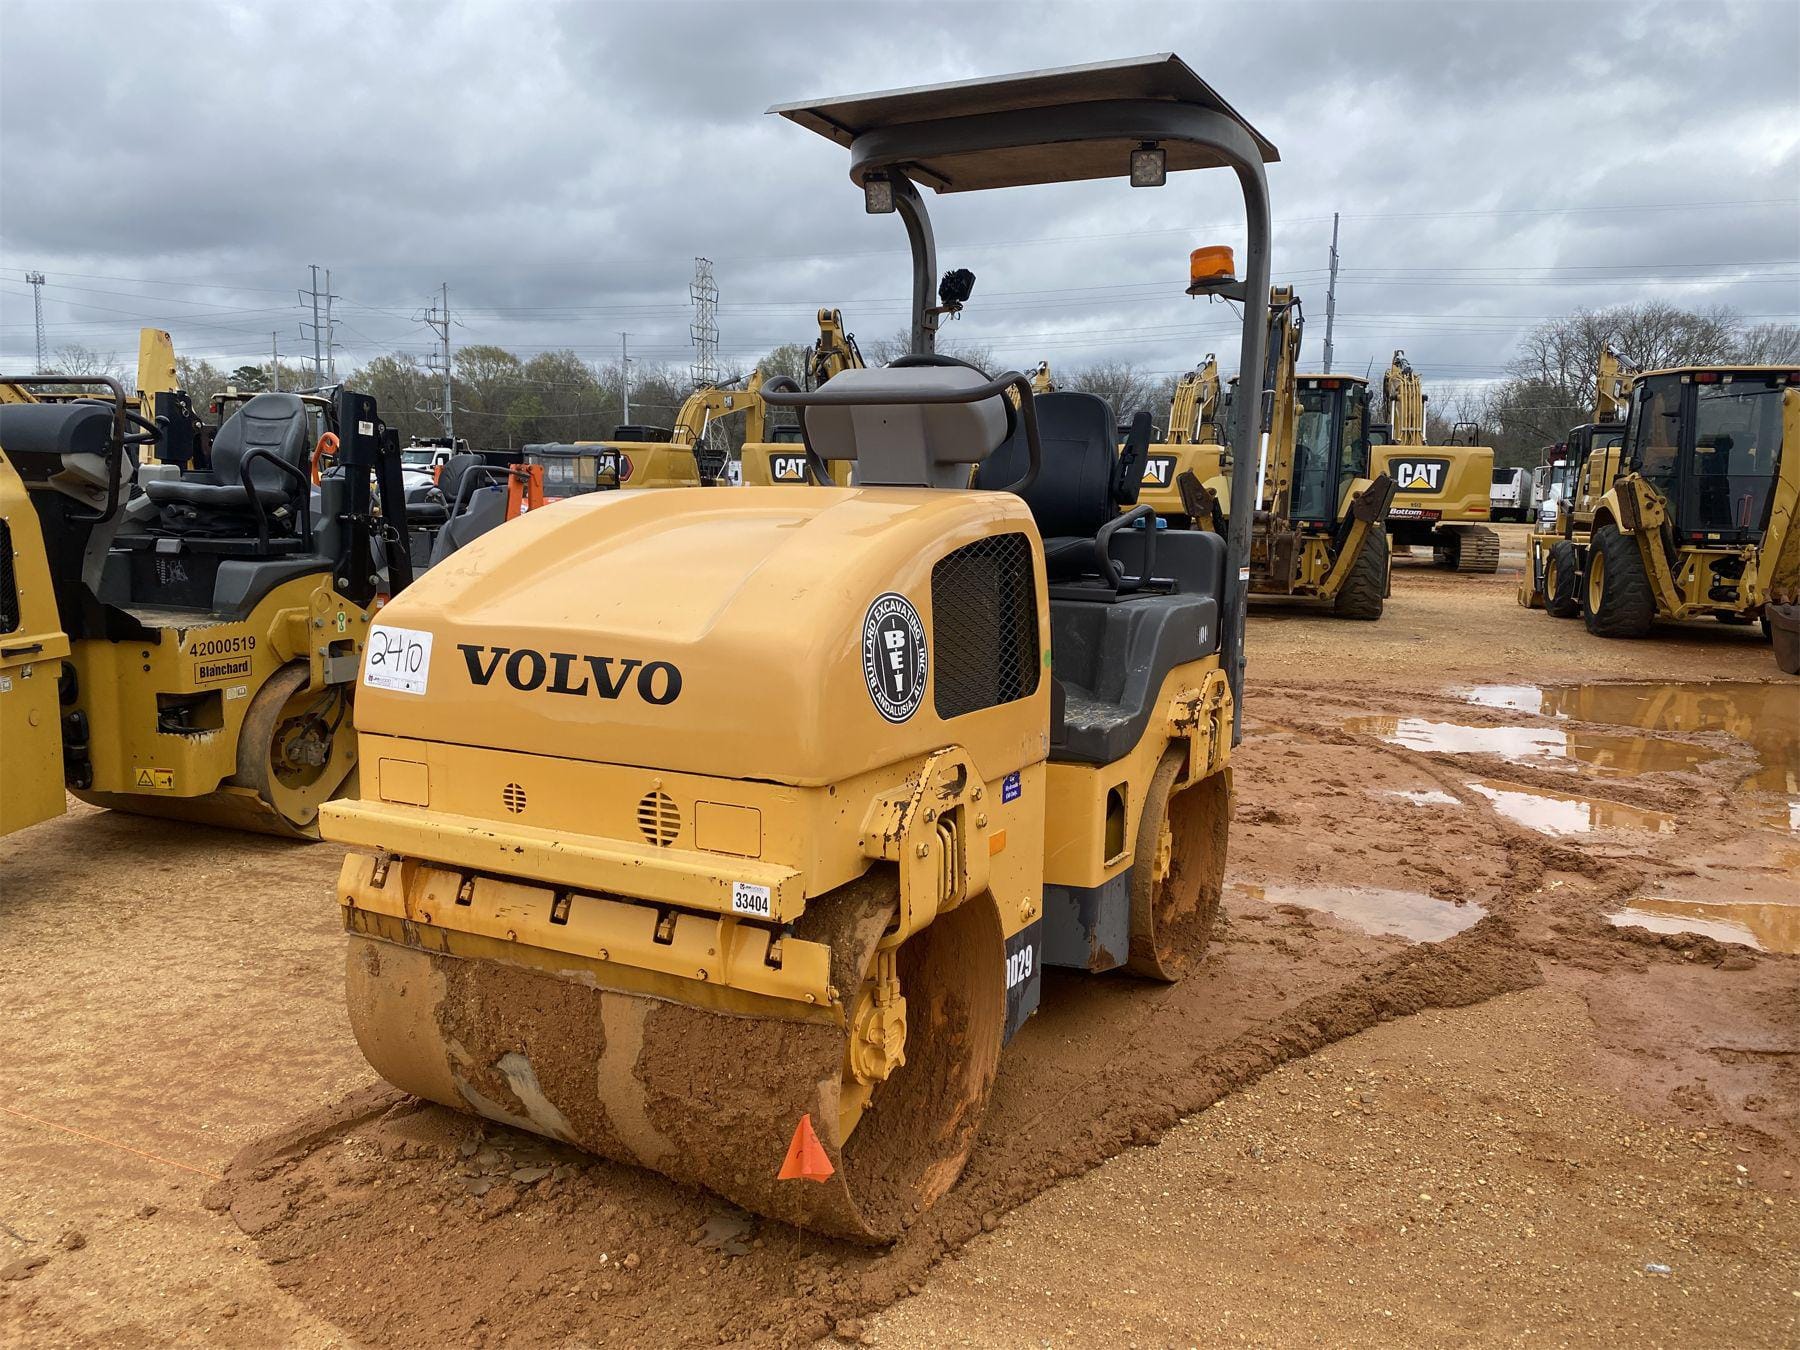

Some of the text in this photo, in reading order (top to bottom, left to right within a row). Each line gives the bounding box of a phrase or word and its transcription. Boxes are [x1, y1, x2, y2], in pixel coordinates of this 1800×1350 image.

[775, 458, 806, 478] CAT
[1143, 460, 1169, 483] AT
[1398, 463, 1441, 488] CAT
[189, 636, 256, 657] 42000519
[371, 631, 423, 673] 2410
[866, 601, 926, 689] BULLARD EXCAVATING, INC.
[199, 660, 249, 679] Blanchard
[457, 644, 683, 705] VOLVO
[876, 685, 922, 716] ANDALUSIA, AL
[735, 892, 768, 913] 33404
